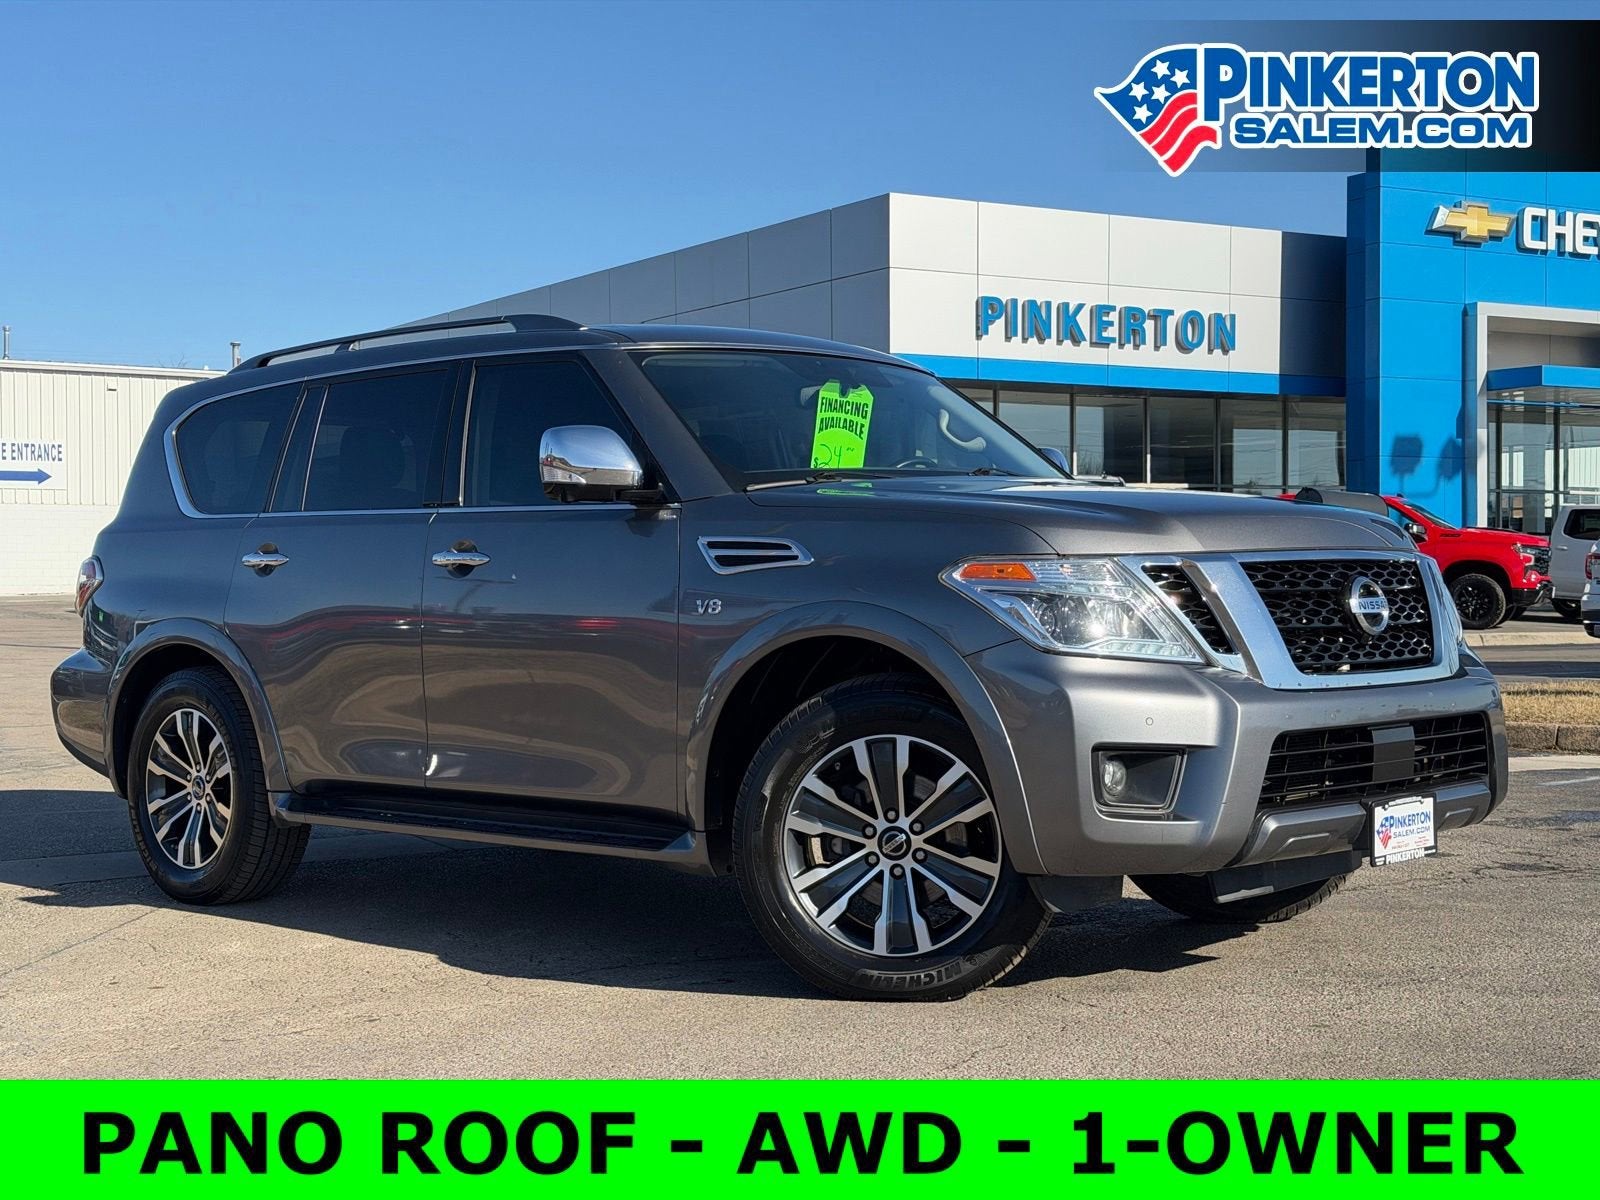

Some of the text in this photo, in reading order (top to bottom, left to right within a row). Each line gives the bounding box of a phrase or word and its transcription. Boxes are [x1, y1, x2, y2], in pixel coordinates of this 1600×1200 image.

[1522, 206, 1600, 255] CHE
[976, 295, 1237, 354] PINKERTON
[820, 397, 868, 419] FINANCING
[818, 417, 865, 440] AVAILABLE
[11, 443, 62, 462] ENTRANCE
[695, 598, 722, 615] V8
[1359, 599, 1387, 610] NISSA
[1389, 811, 1430, 830] PINKERTON
[1392, 826, 1431, 839] SALEM.COM
[1385, 848, 1425, 865] PINKERTON
[855, 961, 963, 989] MICHELIN
